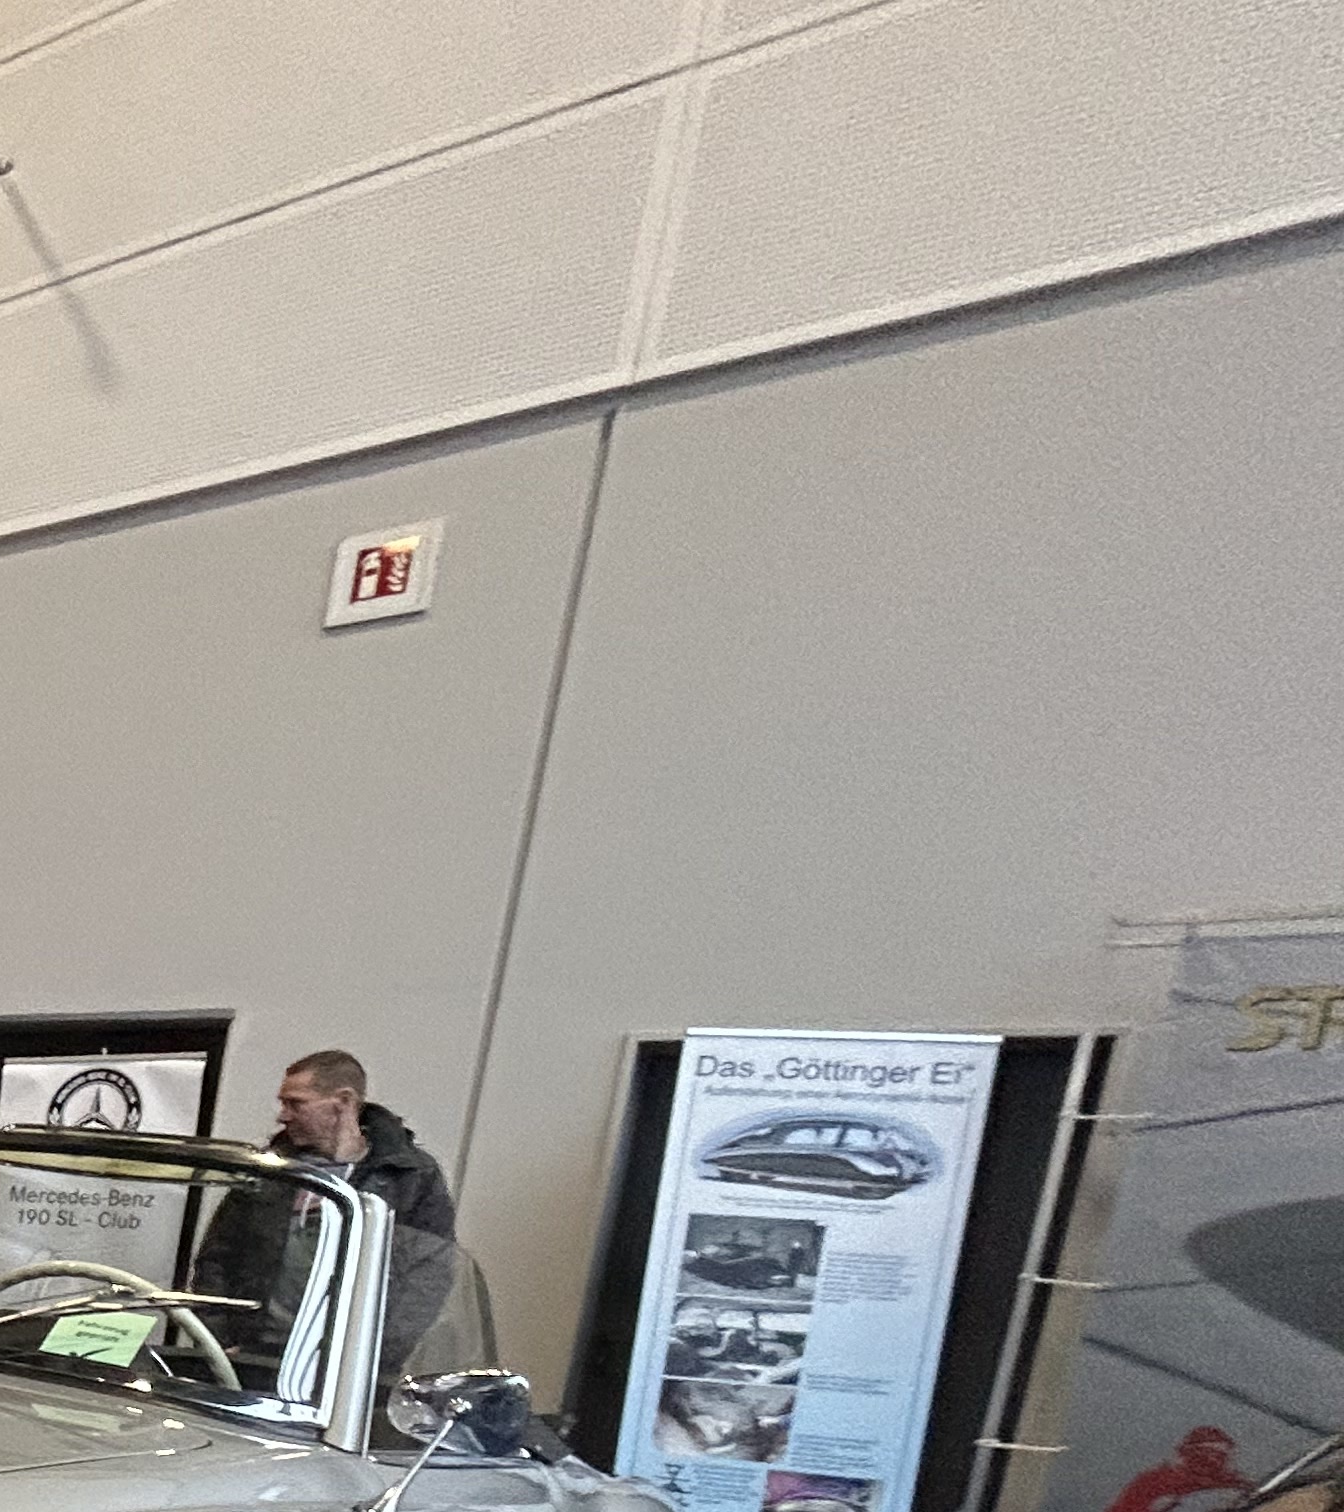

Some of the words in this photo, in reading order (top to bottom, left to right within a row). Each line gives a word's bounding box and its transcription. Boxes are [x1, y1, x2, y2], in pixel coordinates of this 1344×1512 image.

[695, 1055, 756, 1079] Das
[17, 1208, 50, 1226] 190
[55, 1209, 79, 1227] SL
[97, 1210, 142, 1229] Club
